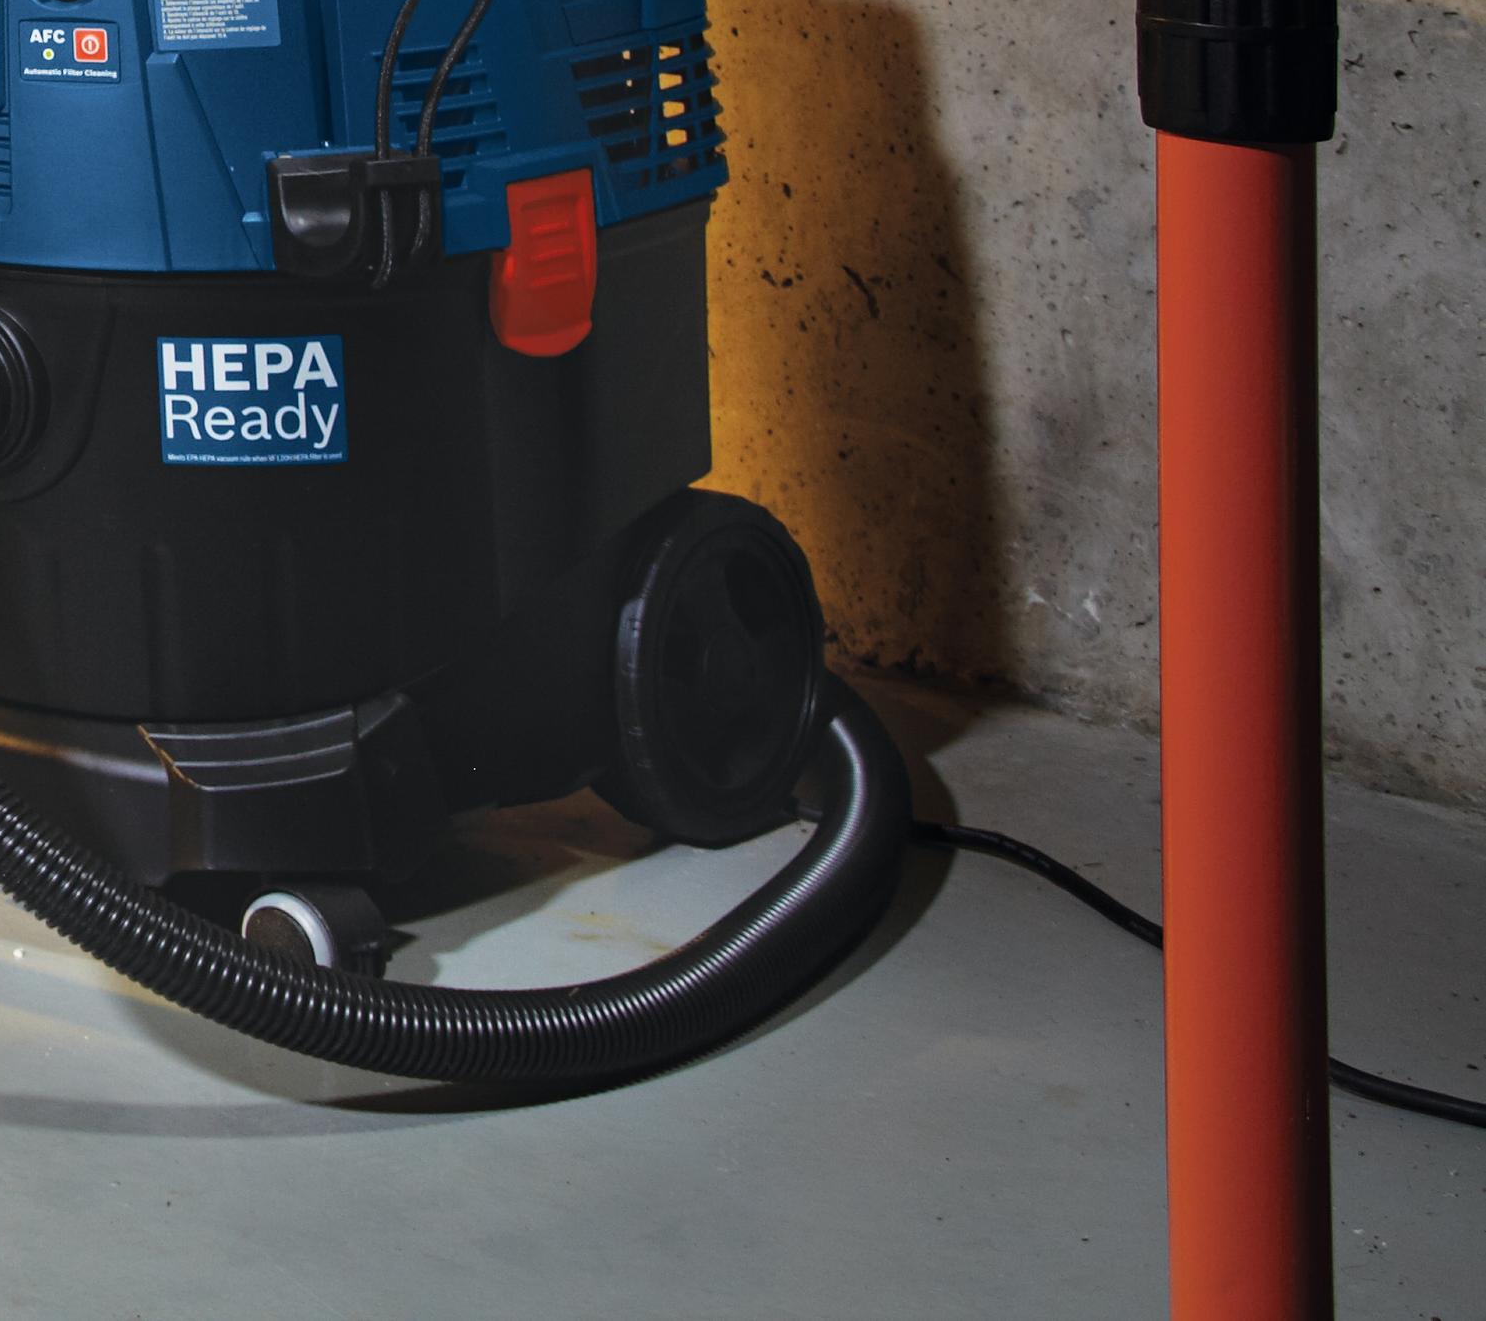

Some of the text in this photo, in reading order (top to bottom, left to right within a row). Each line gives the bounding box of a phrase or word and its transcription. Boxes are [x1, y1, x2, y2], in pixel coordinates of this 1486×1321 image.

[30, 28, 66, 44] AFC
[24, 67, 118, 79] Automatic Filter Cleaning
[161, 341, 338, 391] HEPA
[164, 391, 339, 449] Ready
